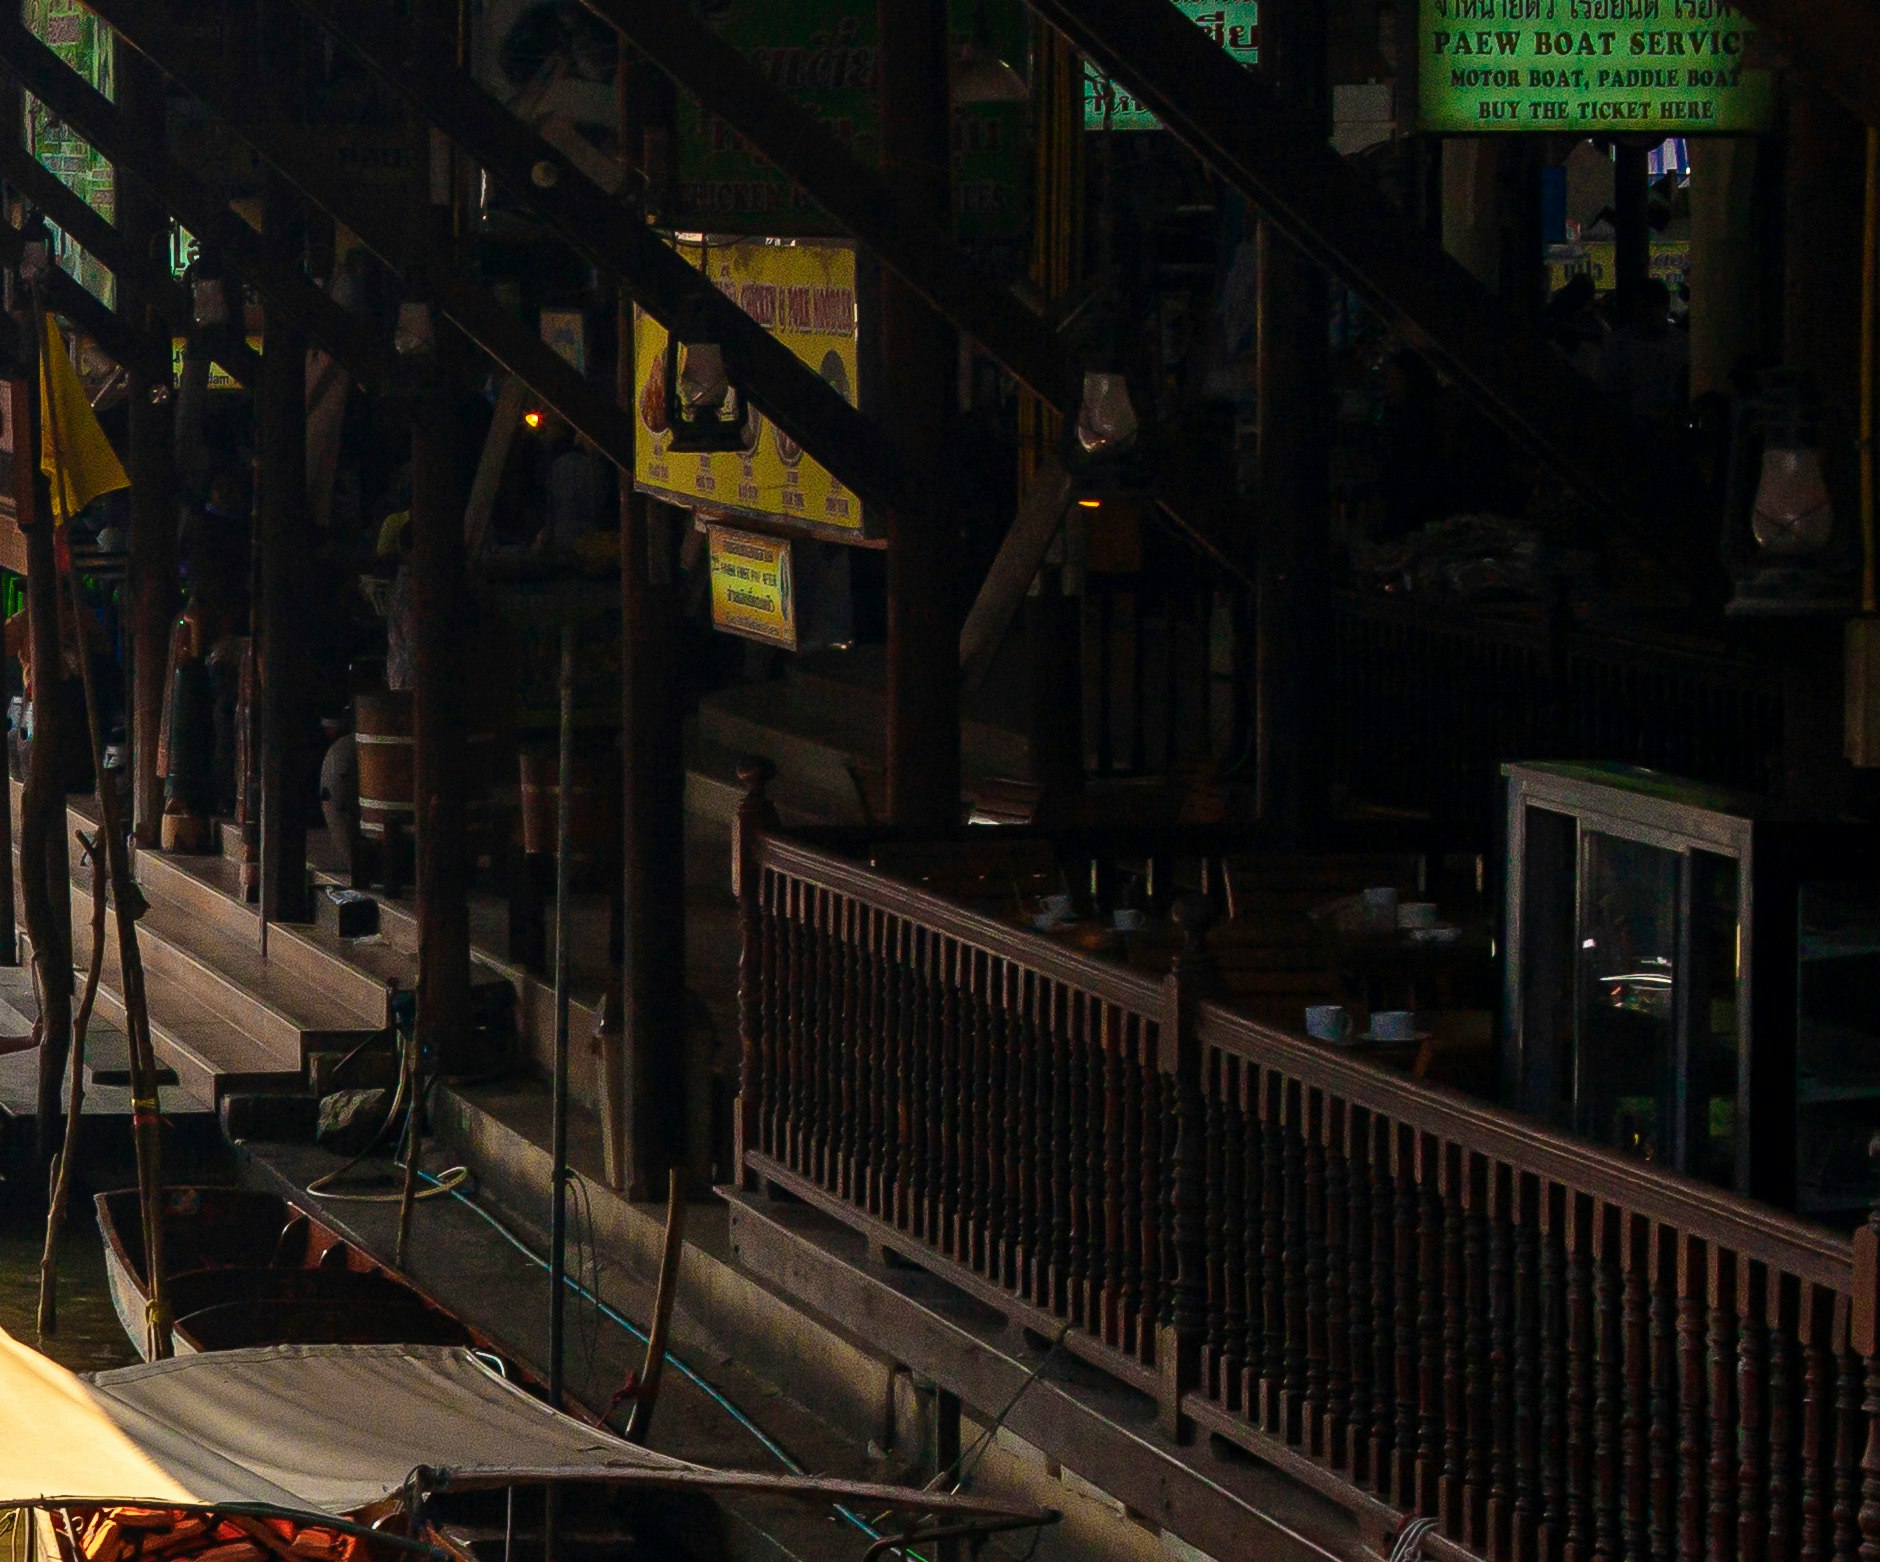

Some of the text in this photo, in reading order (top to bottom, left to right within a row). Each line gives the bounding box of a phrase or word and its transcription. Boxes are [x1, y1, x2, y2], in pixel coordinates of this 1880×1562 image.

[1434, 31, 1521, 56] PAEW
[1535, 31, 1616, 56] BOAT
[1450, 69, 1520, 87] MOTOR
[1528, 69, 1590, 90] BOAT,
[1598, 69, 1679, 87] PADDLE
[1478, 101, 1714, 119] BUY THE TICKET HERE
